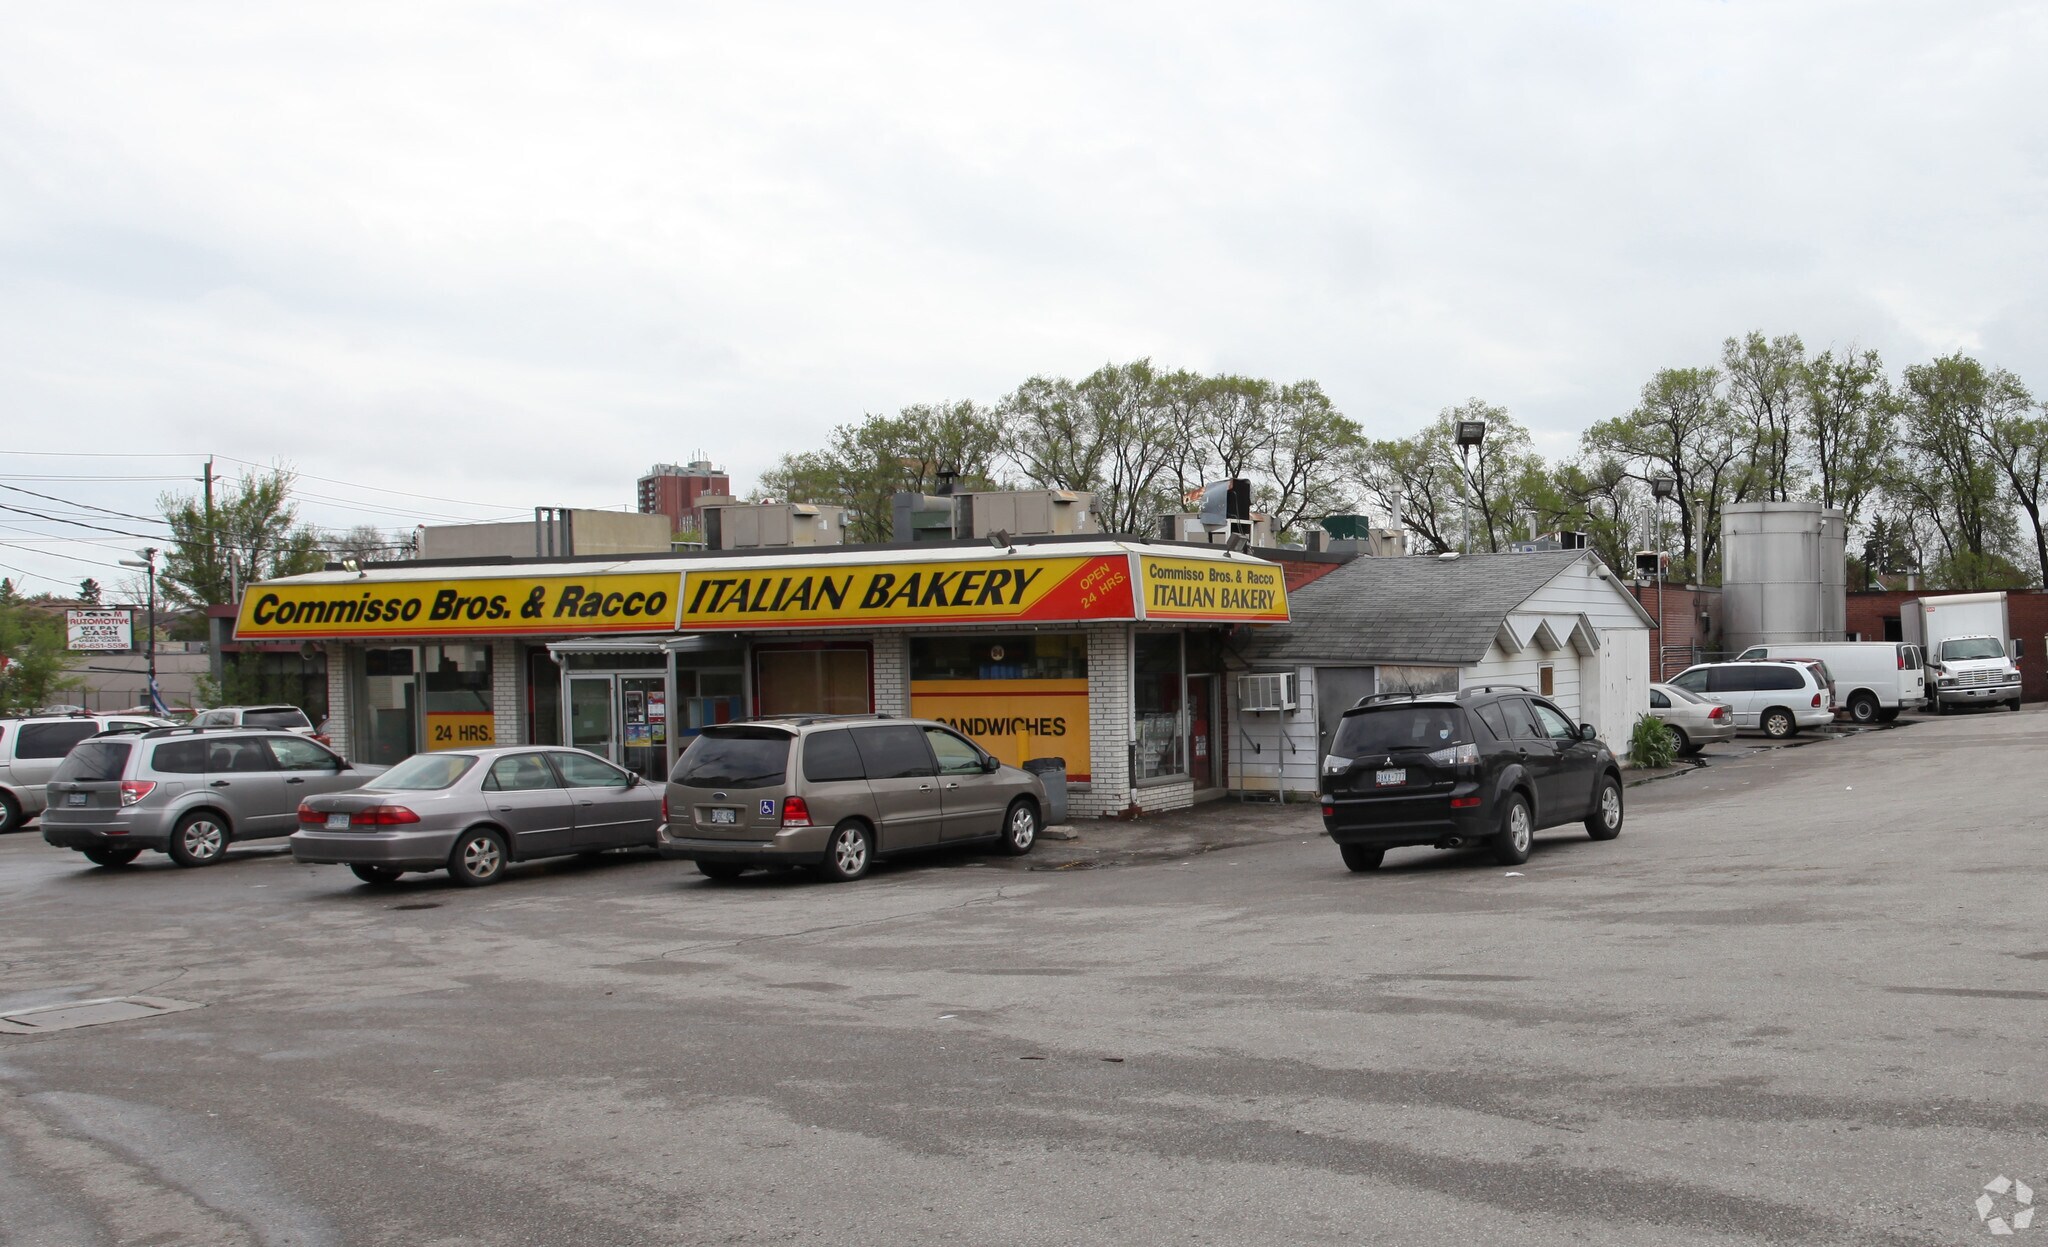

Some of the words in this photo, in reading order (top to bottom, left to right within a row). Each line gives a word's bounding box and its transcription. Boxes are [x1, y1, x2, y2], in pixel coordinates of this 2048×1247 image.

[1080, 562, 1110, 590] OPEN
[1150, 563, 1204, 581] Commisso
[1209, 568, 1233, 583] Bros.
[1236, 569, 1242, 583] &
[1247, 571, 1274, 585] Racco
[688, 575, 854, 614] ITALIAN
[859, 567, 1044, 609] BAKERY
[1081, 592, 1097, 609] 24
[1099, 572, 1126, 595] HRS.
[1153, 584, 1215, 608] ITALIAN
[1221, 587, 1276, 610] BAKERY
[253, 592, 422, 625] Commisso
[429, 589, 511, 621] Bros.
[520, 585, 546, 618] &
[553, 585, 668, 618] Racco
[435, 725, 452, 741] 24
[459, 725, 492, 741] HRS.
